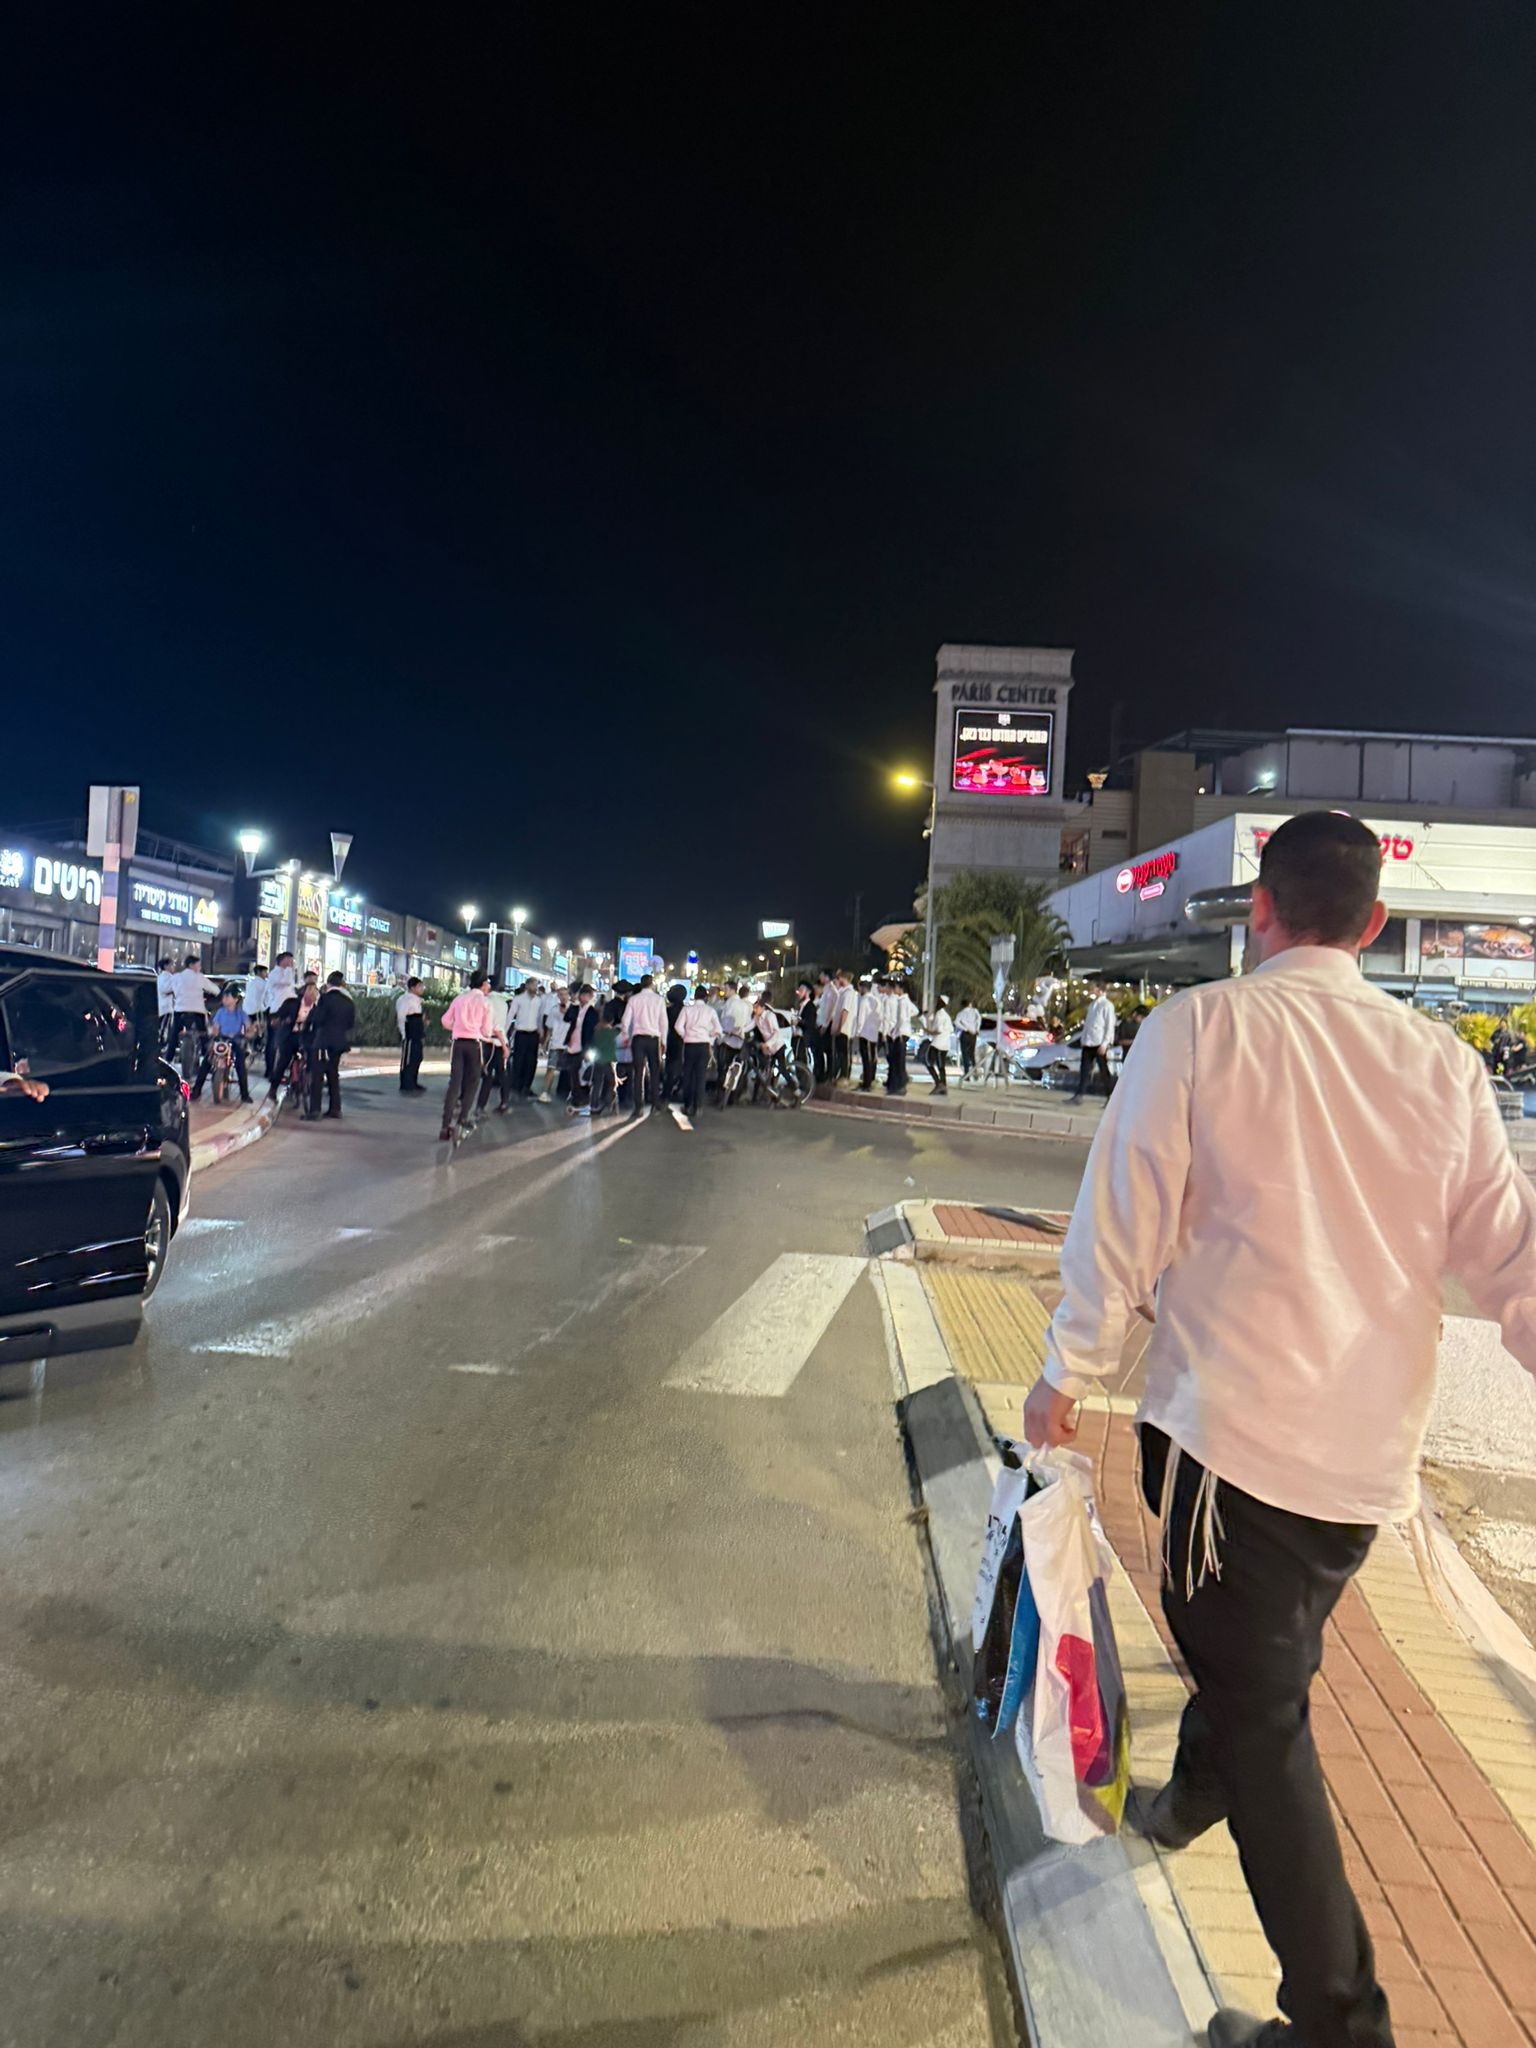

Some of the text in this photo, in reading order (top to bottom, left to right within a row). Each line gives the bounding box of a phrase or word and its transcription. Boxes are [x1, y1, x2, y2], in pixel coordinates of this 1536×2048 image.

[951, 683, 1056, 704] PARIS CENTER
[34, 856, 104, 906] היטים
